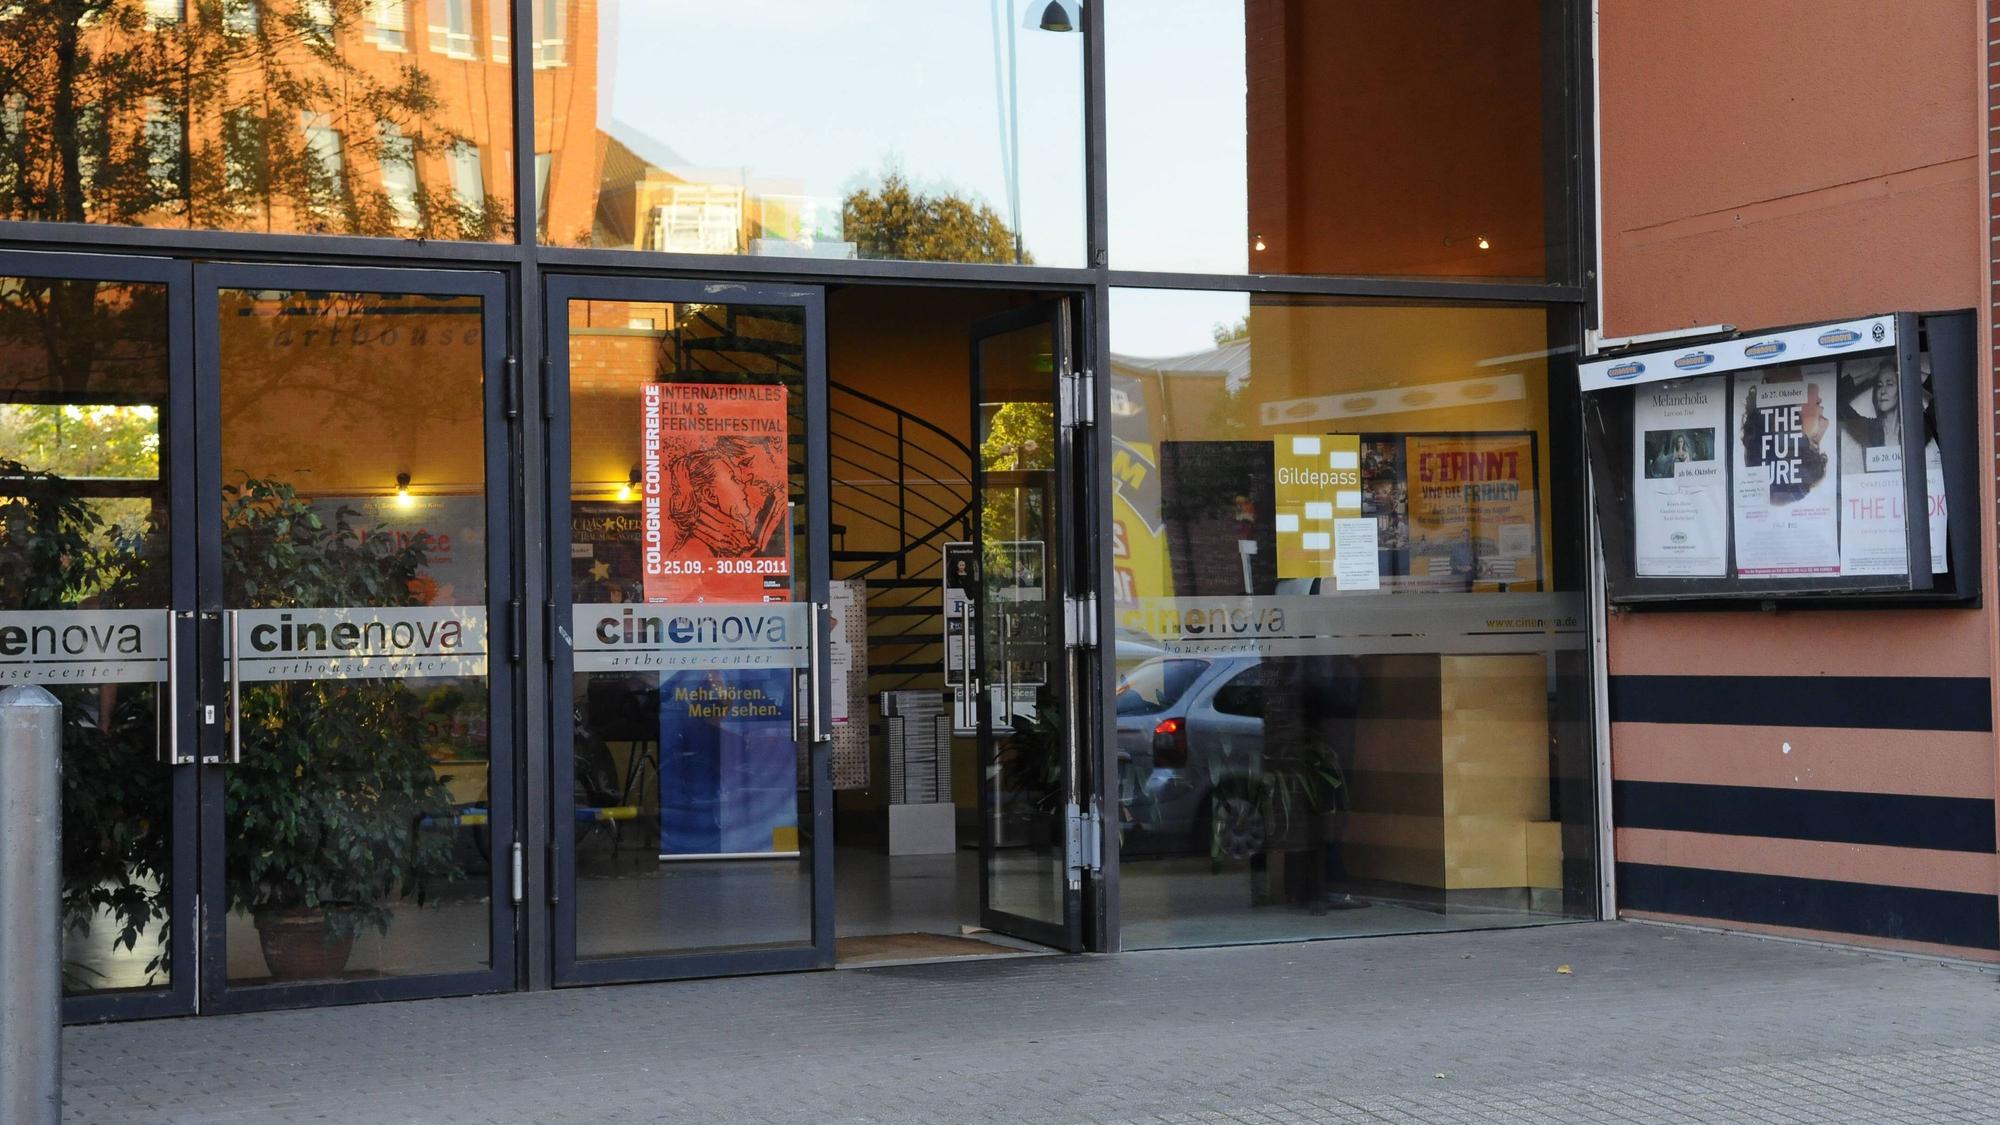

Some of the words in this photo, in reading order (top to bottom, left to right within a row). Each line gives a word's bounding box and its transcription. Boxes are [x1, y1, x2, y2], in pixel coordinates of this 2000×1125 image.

[661, 386, 782, 401] INTERNATIONALES
[1652, 392, 1708, 408] Melancholia
[1779, 389, 1802, 398] Oktober
[661, 402, 693, 416] FILM
[697, 402, 708, 416] &
[661, 417, 784, 433] FERNSEHFESTIVAL
[1760, 407, 1802, 433] THE
[645, 385, 660, 493] CONFERENCE
[1761, 433, 1803, 460] FUT
[1278, 467, 1357, 488] Gildepass
[1849, 496, 1886, 520] THE
[1892, 494, 1946, 519] LOK
[646, 496, 661, 575] COLOGNE
[664, 560, 705, 574] 25.09.
[716, 560, 788, 574] 30.09.2011
[596, 608, 787, 645] cinenova
[1122, 607, 1286, 635] cinenova
[1487, 616, 1577, 629] www.cinenva.de
[250, 612, 463, 652] cinenova
[612, 652, 773, 666] arthouse-center
[268, 660, 448, 676] arthouse-center
[675, 688, 714, 701] Mehr
[719, 686, 766, 701] hören.
[688, 704, 728, 718] Mehr
[731, 703, 782, 717] sehen.
